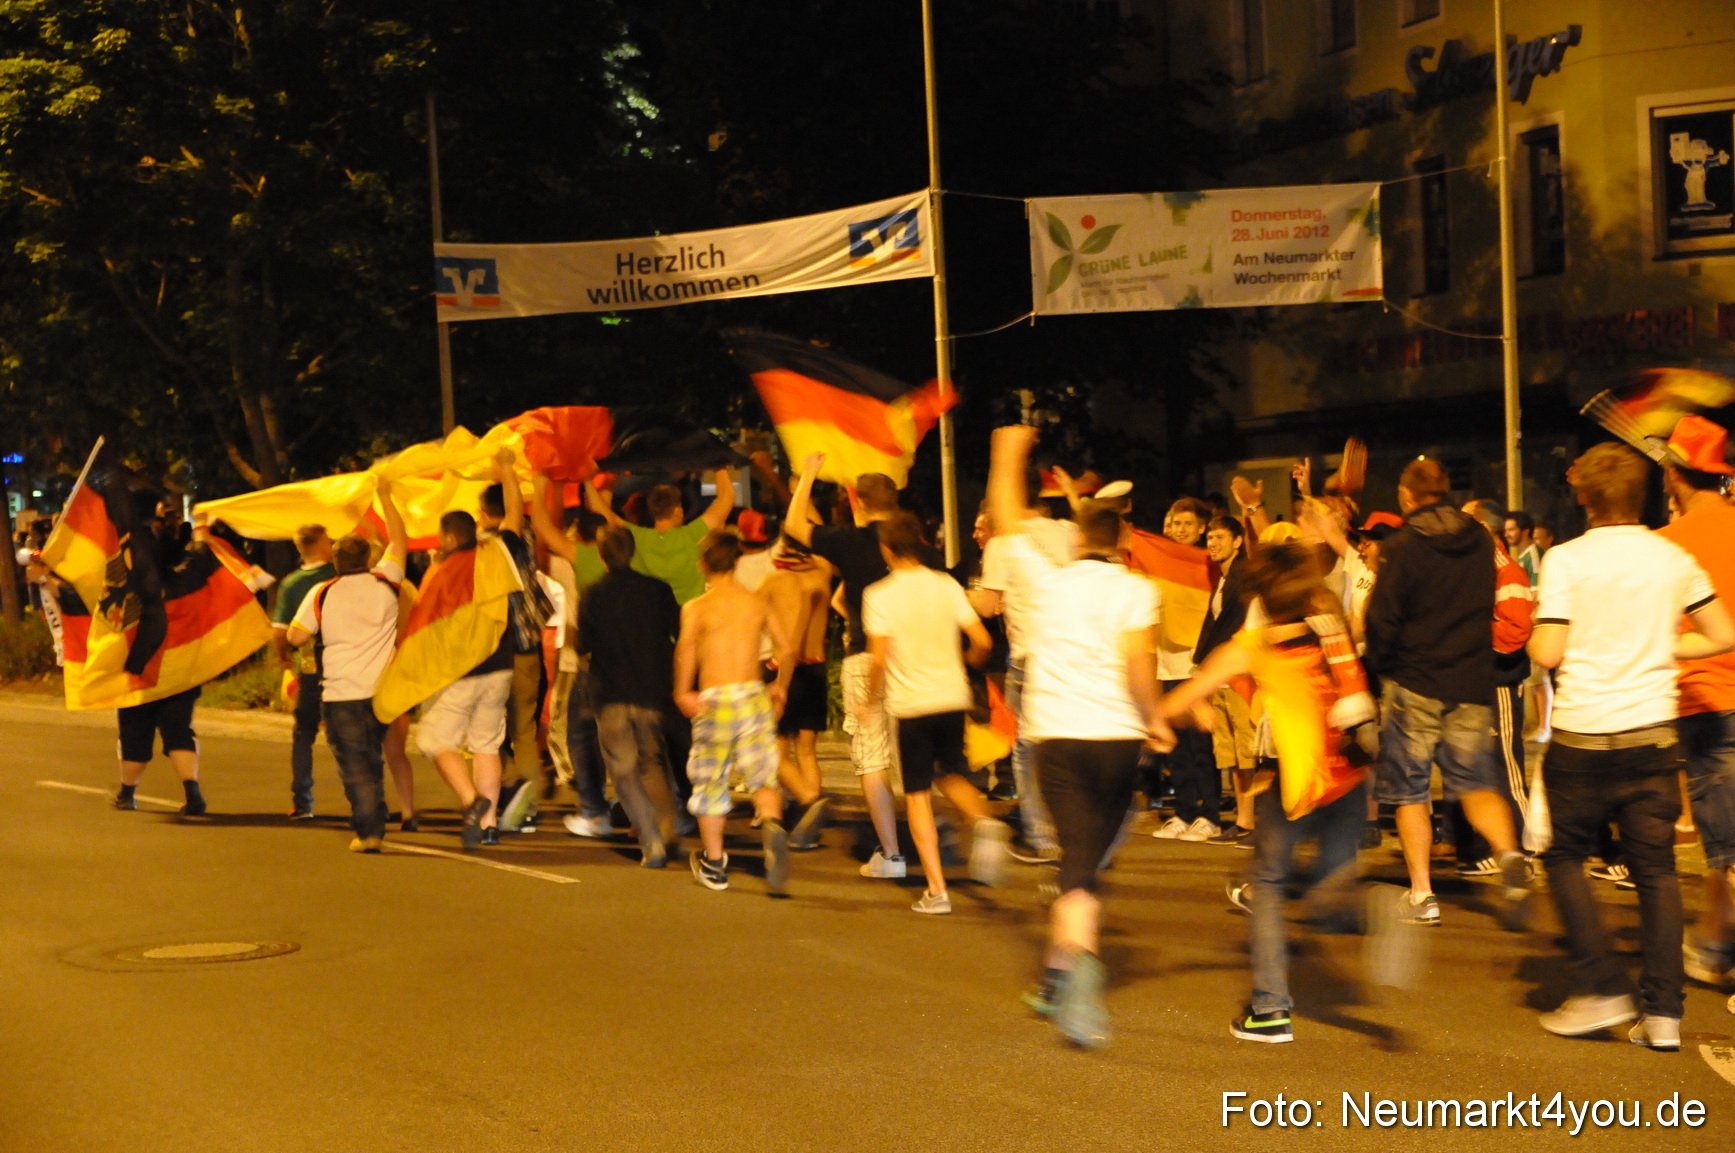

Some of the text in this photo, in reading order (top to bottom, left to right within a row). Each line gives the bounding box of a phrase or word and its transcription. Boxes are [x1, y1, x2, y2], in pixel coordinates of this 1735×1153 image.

[1231, 208, 1327, 222] Donnerstag,
[1231, 225, 1329, 242] 28. Juni 2012
[616, 243, 726, 276] Herzlich
[1078, 244, 1189, 278] GRÜNE LAUNE
[1233, 249, 1355, 266] Am Neumarkter
[1233, 268, 1343, 285] Wochenmarkt
[586, 273, 760, 305] willkommen
